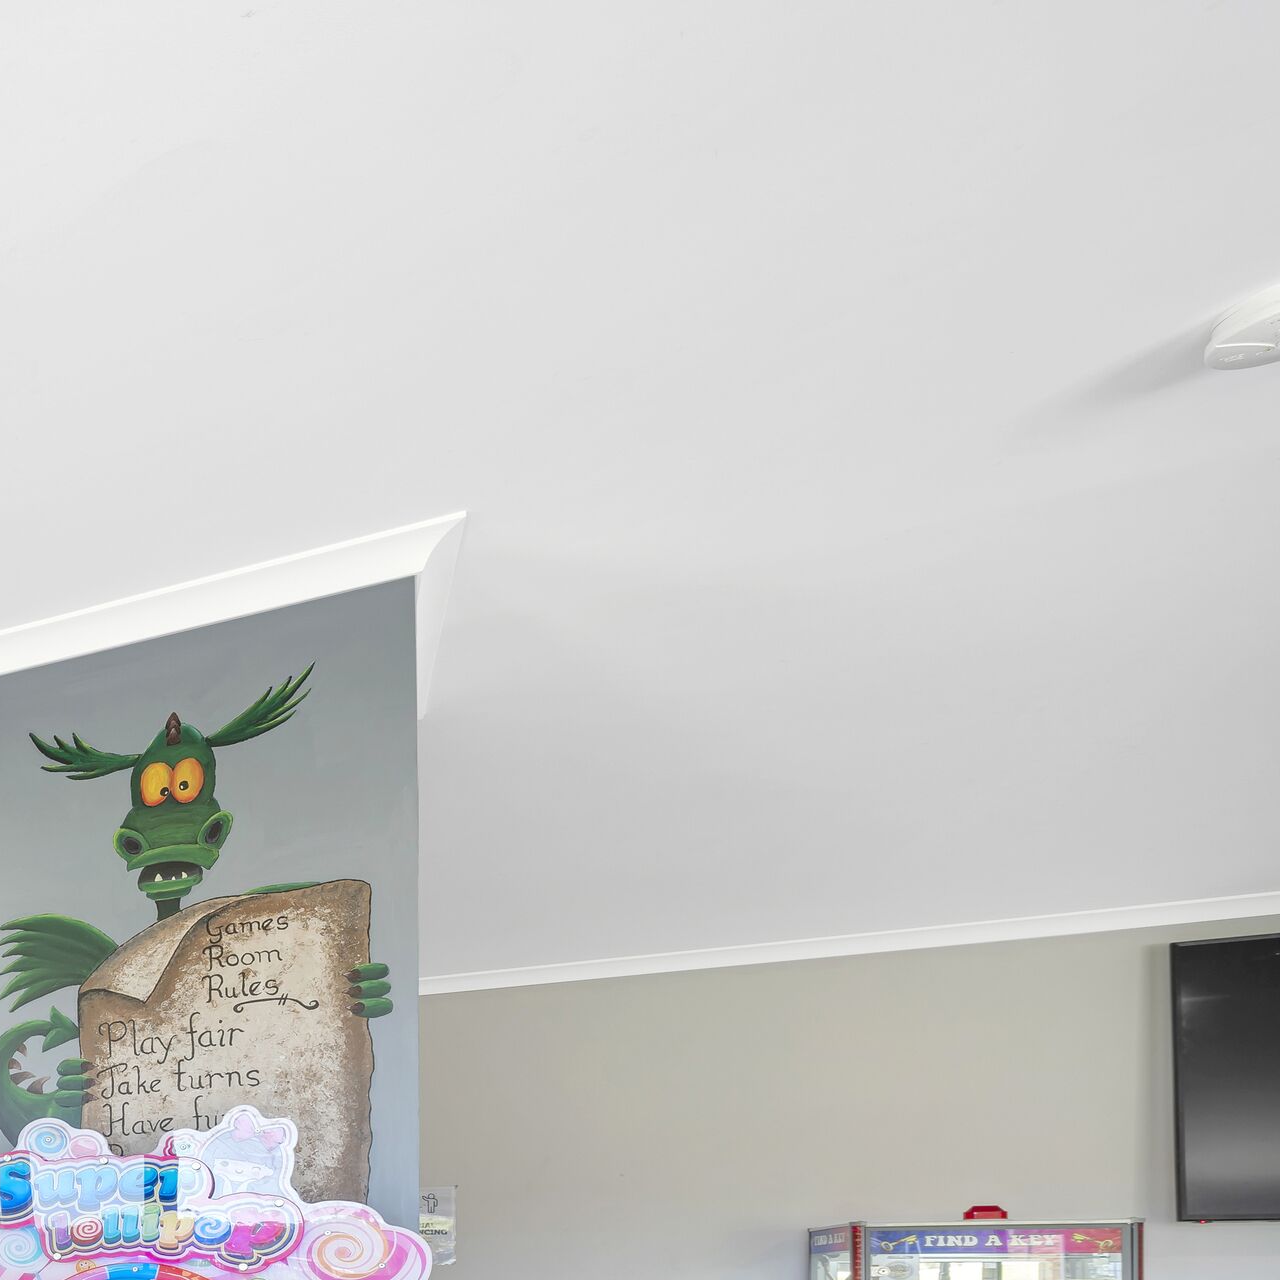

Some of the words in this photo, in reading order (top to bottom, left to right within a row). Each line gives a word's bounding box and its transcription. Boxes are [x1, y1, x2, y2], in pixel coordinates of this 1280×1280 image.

[206, 915, 289, 944] Games
[202, 944, 283, 971] Room
[201, 972, 280, 1003] Rules
[99, 1018, 177, 1064] Play
[184, 1012, 244, 1061] fair
[97, 1063, 161, 1100] Take
[174, 1059, 261, 1092] turns
[102, 1102, 175, 1137] Have
[193, 1095, 225, 1131] fu
[924, 1235, 977, 1248] FIND
[984, 1234, 1003, 1247] A
[1007, 1234, 1059, 1247] KEY
